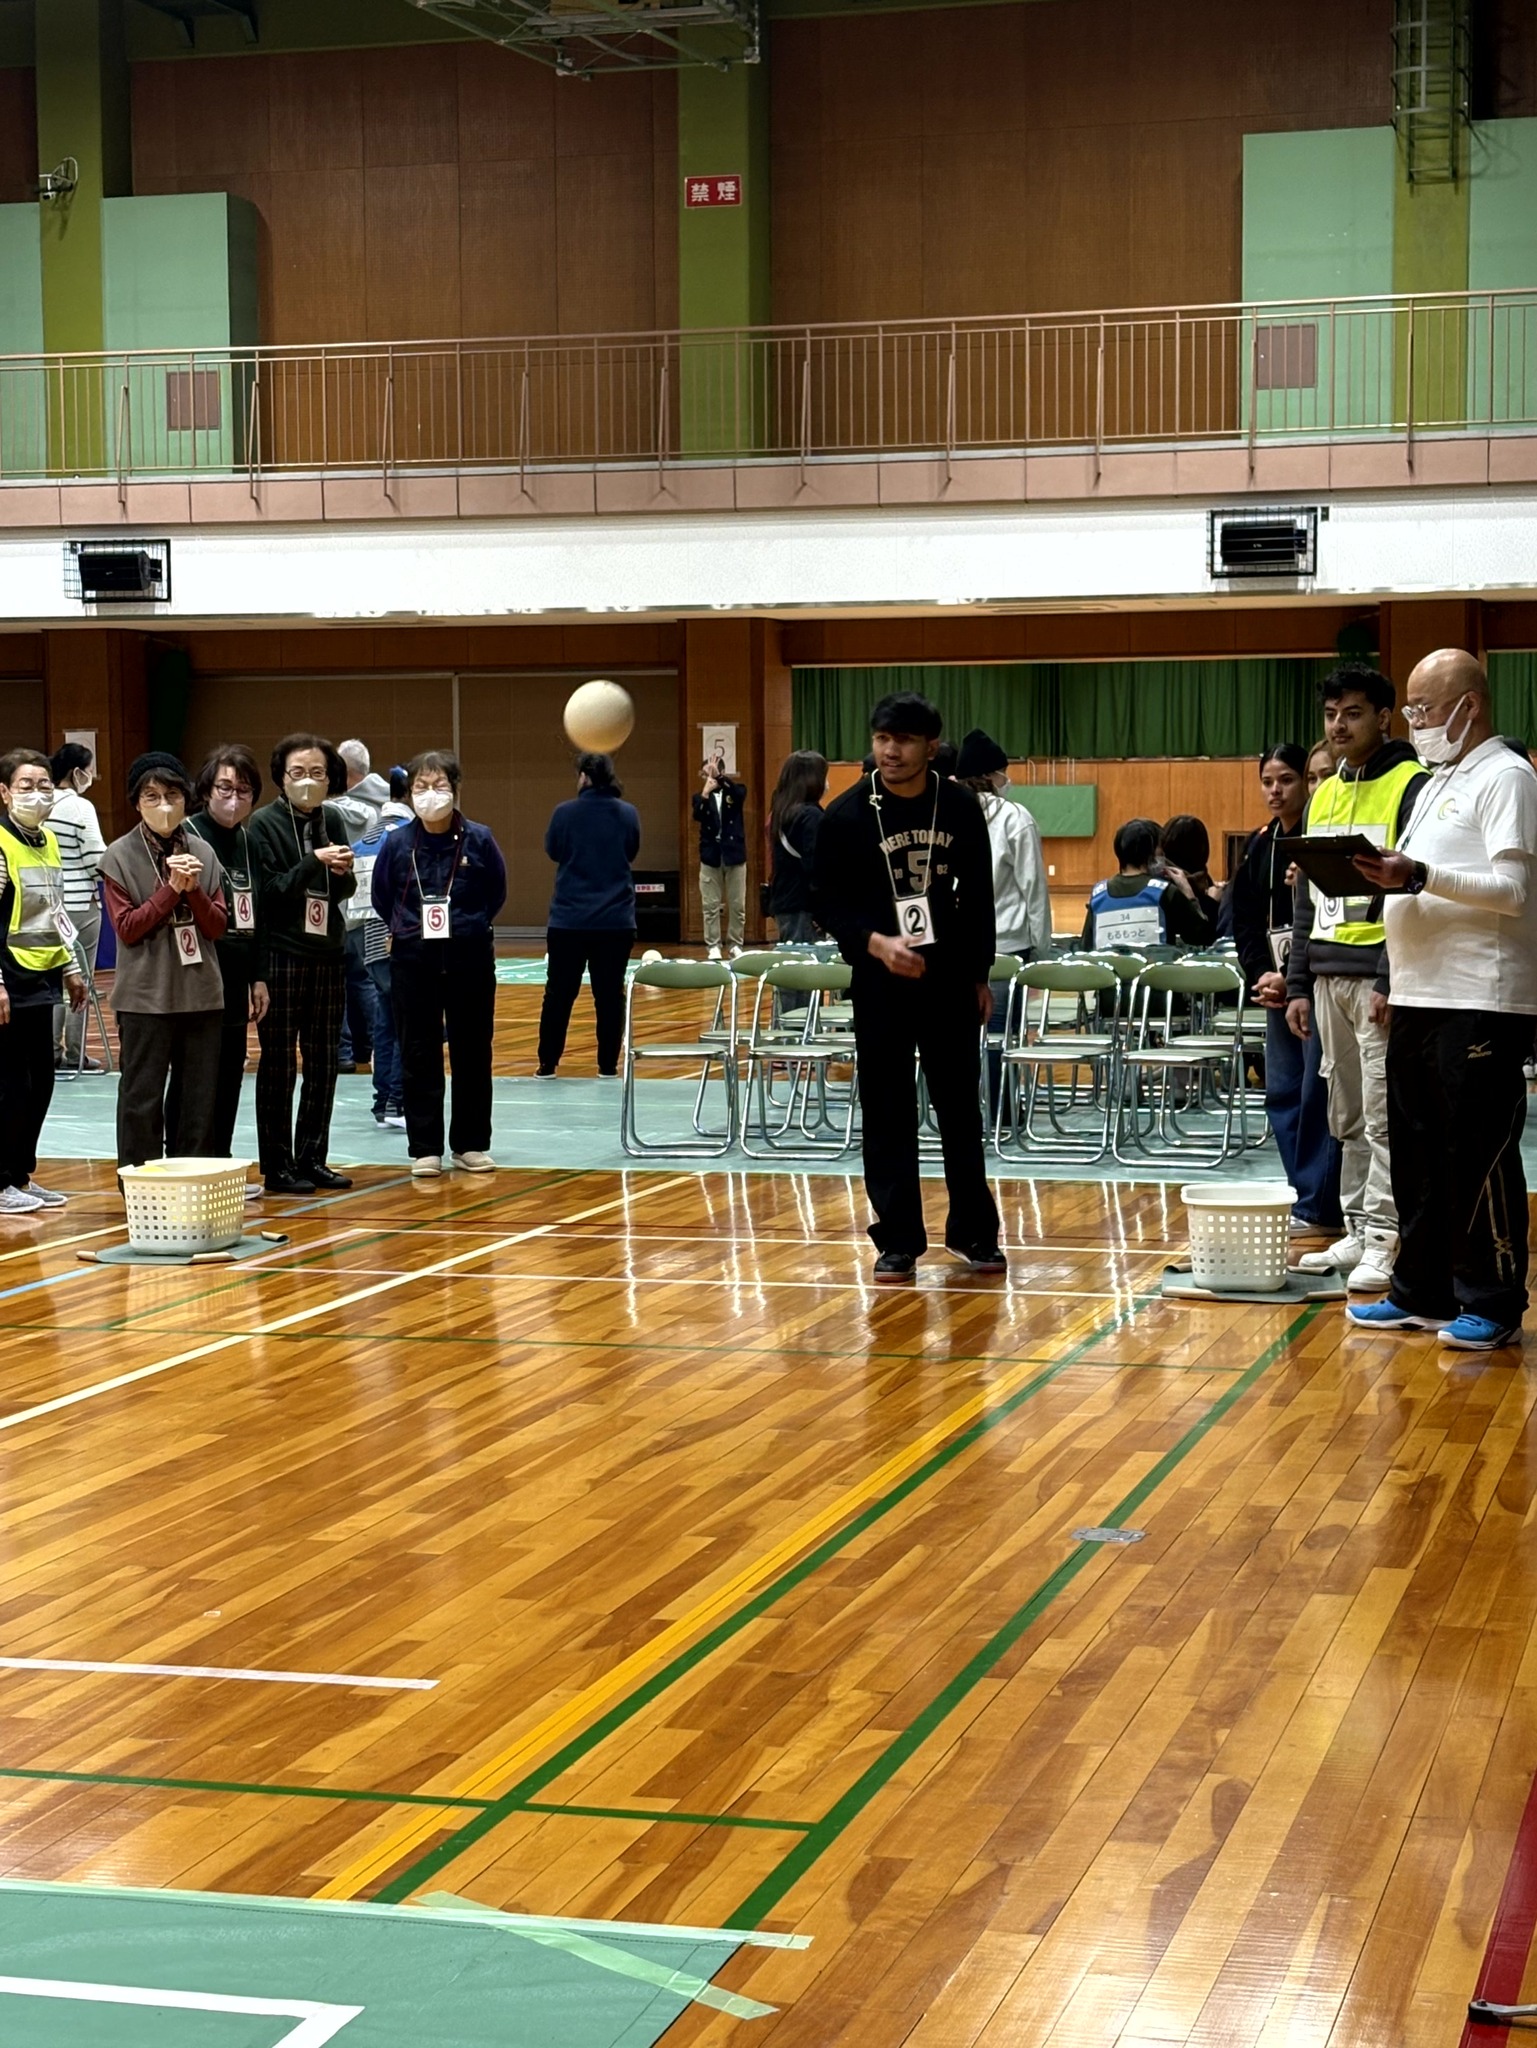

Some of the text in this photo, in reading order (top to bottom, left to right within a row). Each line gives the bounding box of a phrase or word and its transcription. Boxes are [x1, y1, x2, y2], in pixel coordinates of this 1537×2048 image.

[691, 181, 738, 202] 禁煙
[714, 738, 725, 759] 5
[911, 829, 954, 848] TODAY
[908, 850, 932, 892] 5
[908, 907, 924, 933] 2
[1120, 913, 1131, 921] 34
[1107, 928, 1146, 941] もるもっと
